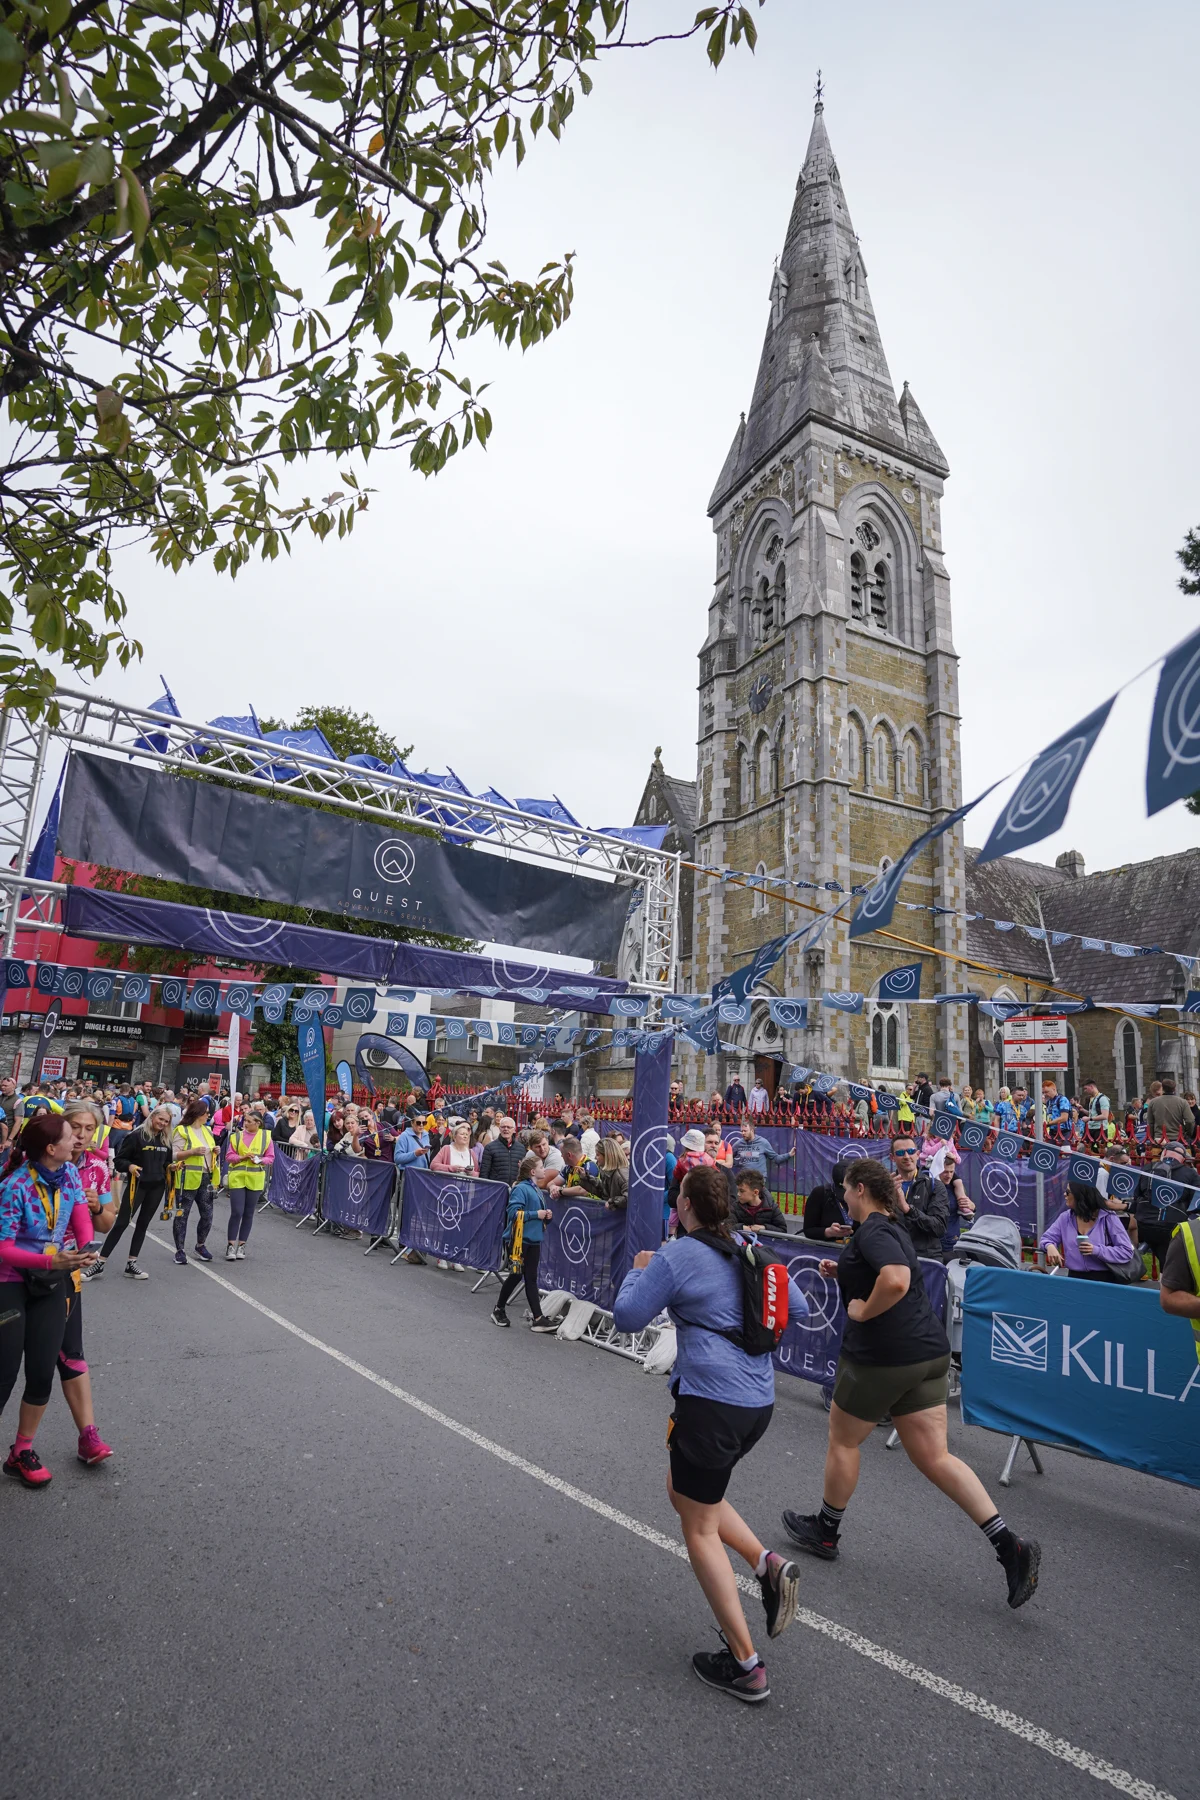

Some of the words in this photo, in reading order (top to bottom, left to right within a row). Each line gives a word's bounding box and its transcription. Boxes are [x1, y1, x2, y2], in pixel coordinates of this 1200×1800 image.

[352, 888, 423, 911] QUEST
[337, 900, 395, 917] ADVENTURE
[400, 912, 433, 924] SERIES
[84, 1022, 106, 1031] DINGLE
[106, 1024, 112, 1032] &
[112, 1025, 126, 1034] SLEA
[127, 1026, 142, 1035] HEAD
[100, 1060, 115, 1068] ONLINE
[186, 1077, 199, 1085] NO
[423, 1239, 470, 1260] QUEST
[544, 1272, 600, 1300] QUEST
[778, 1345, 838, 1377] UES
